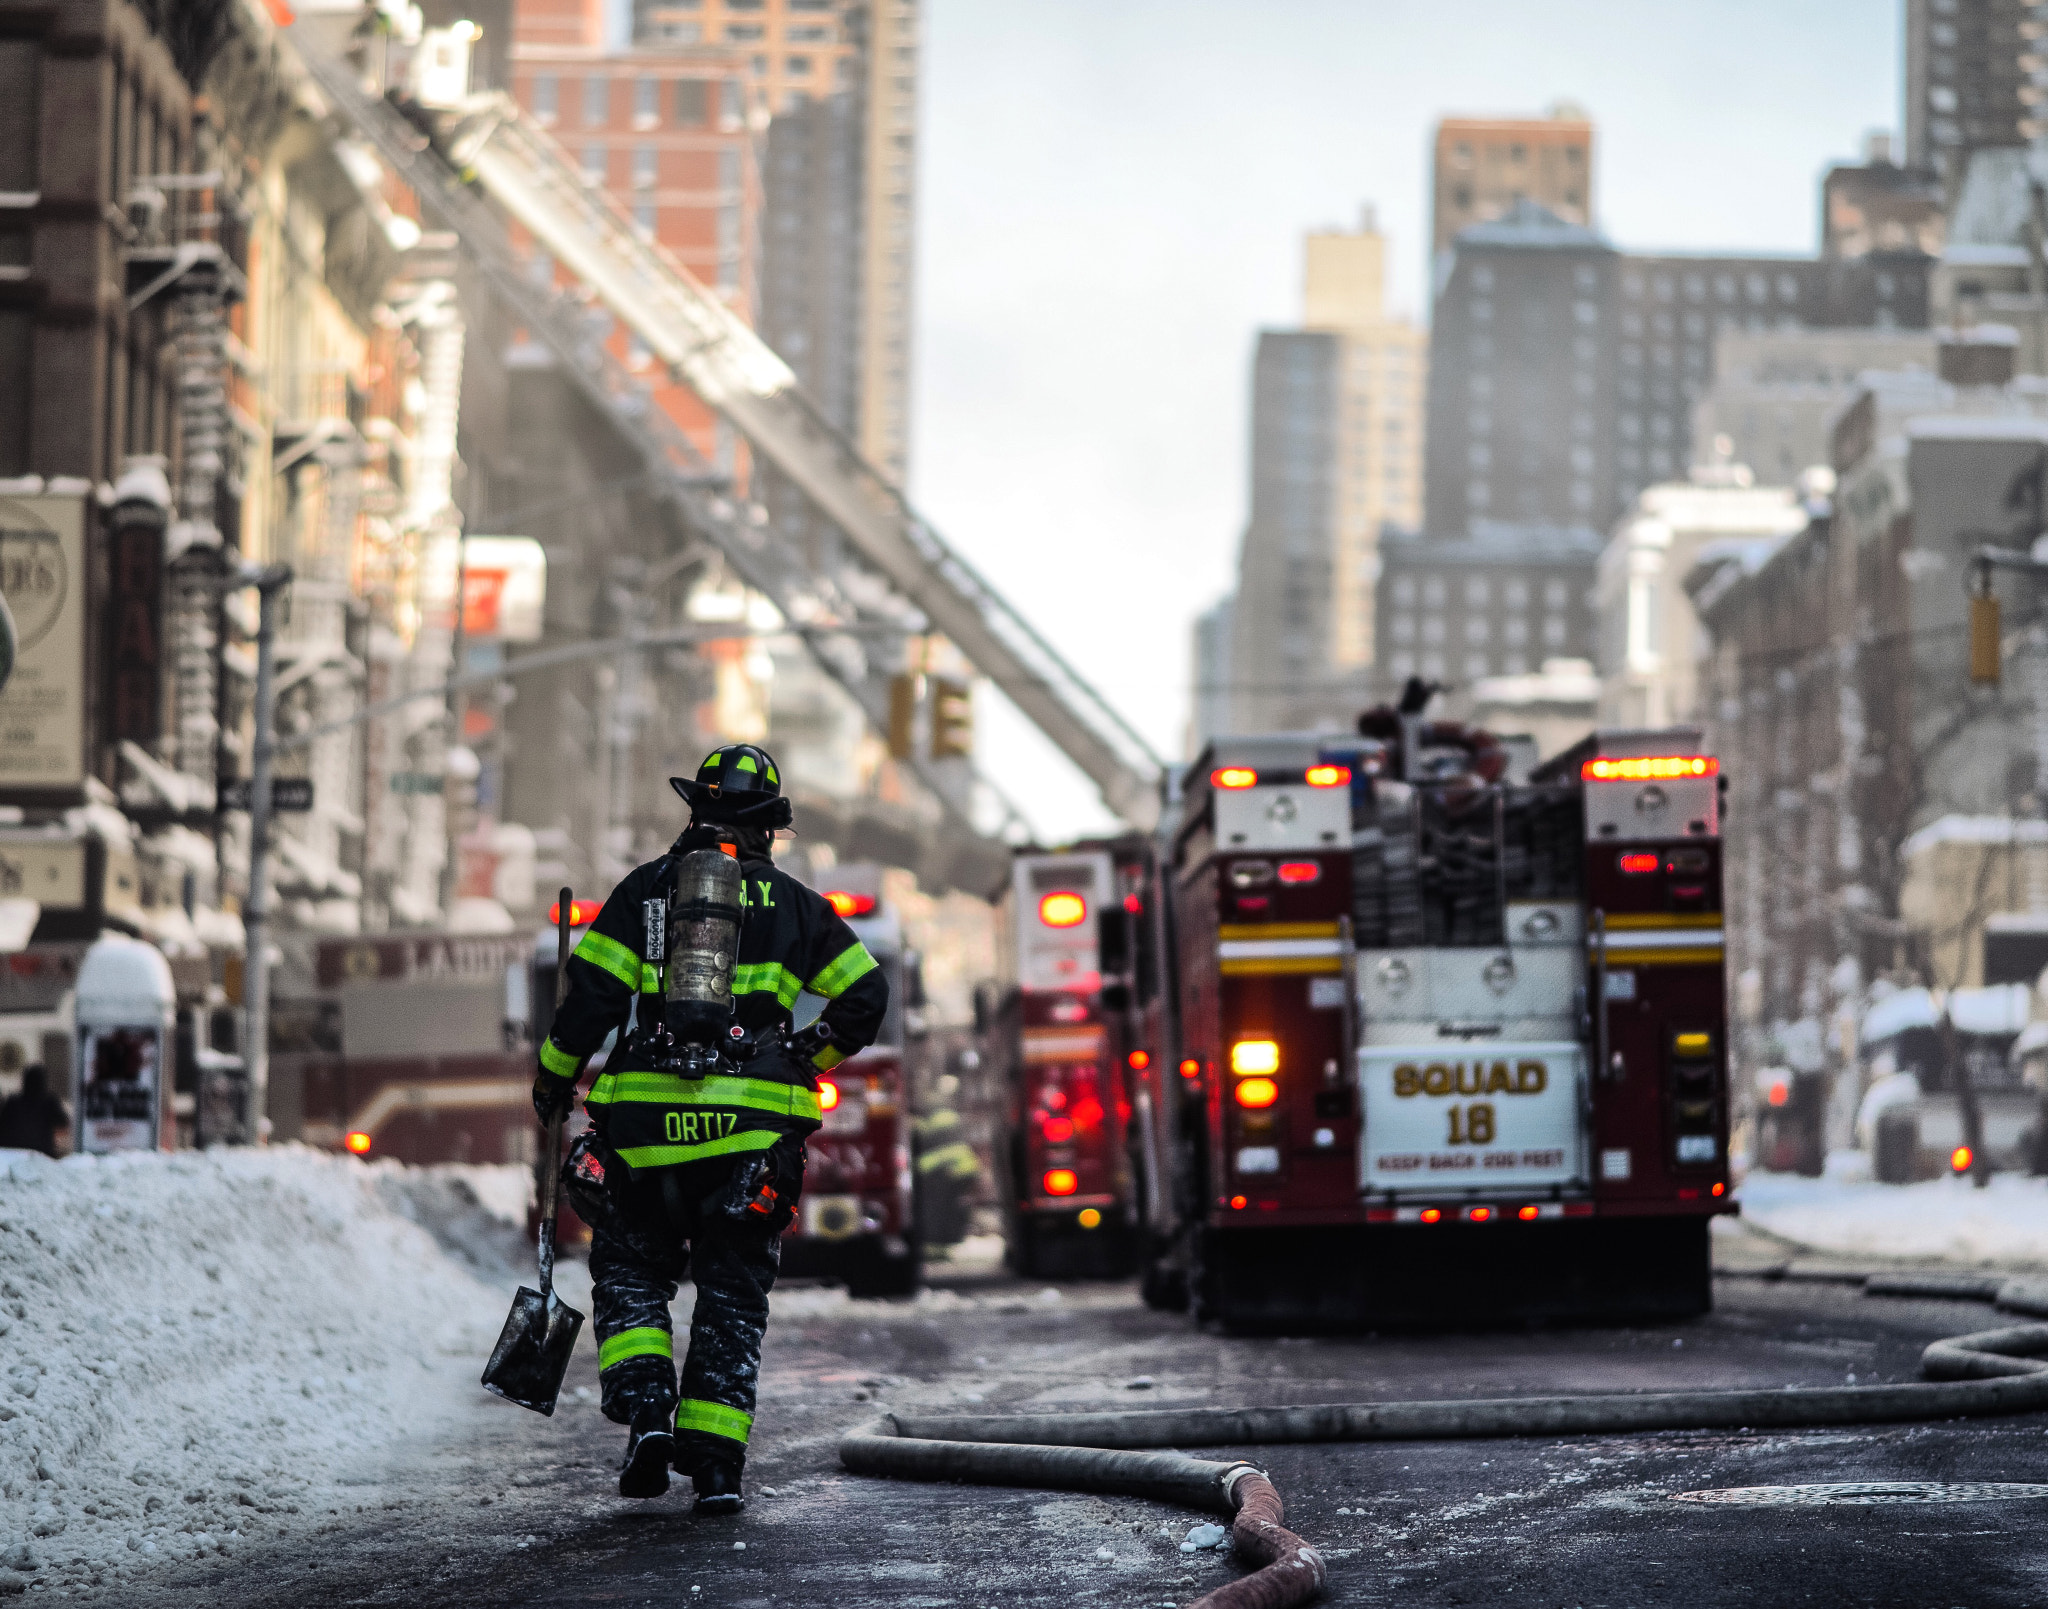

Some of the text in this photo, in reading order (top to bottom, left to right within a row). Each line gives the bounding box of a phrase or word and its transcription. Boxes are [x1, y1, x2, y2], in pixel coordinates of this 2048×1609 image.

[1393, 1060, 1548, 1097] SQUAD
[665, 1111, 738, 1142] ORTIZ
[1446, 1103, 1496, 1146] 18
[1377, 1149, 1565, 1171] KEEP BACK 200 FEET
